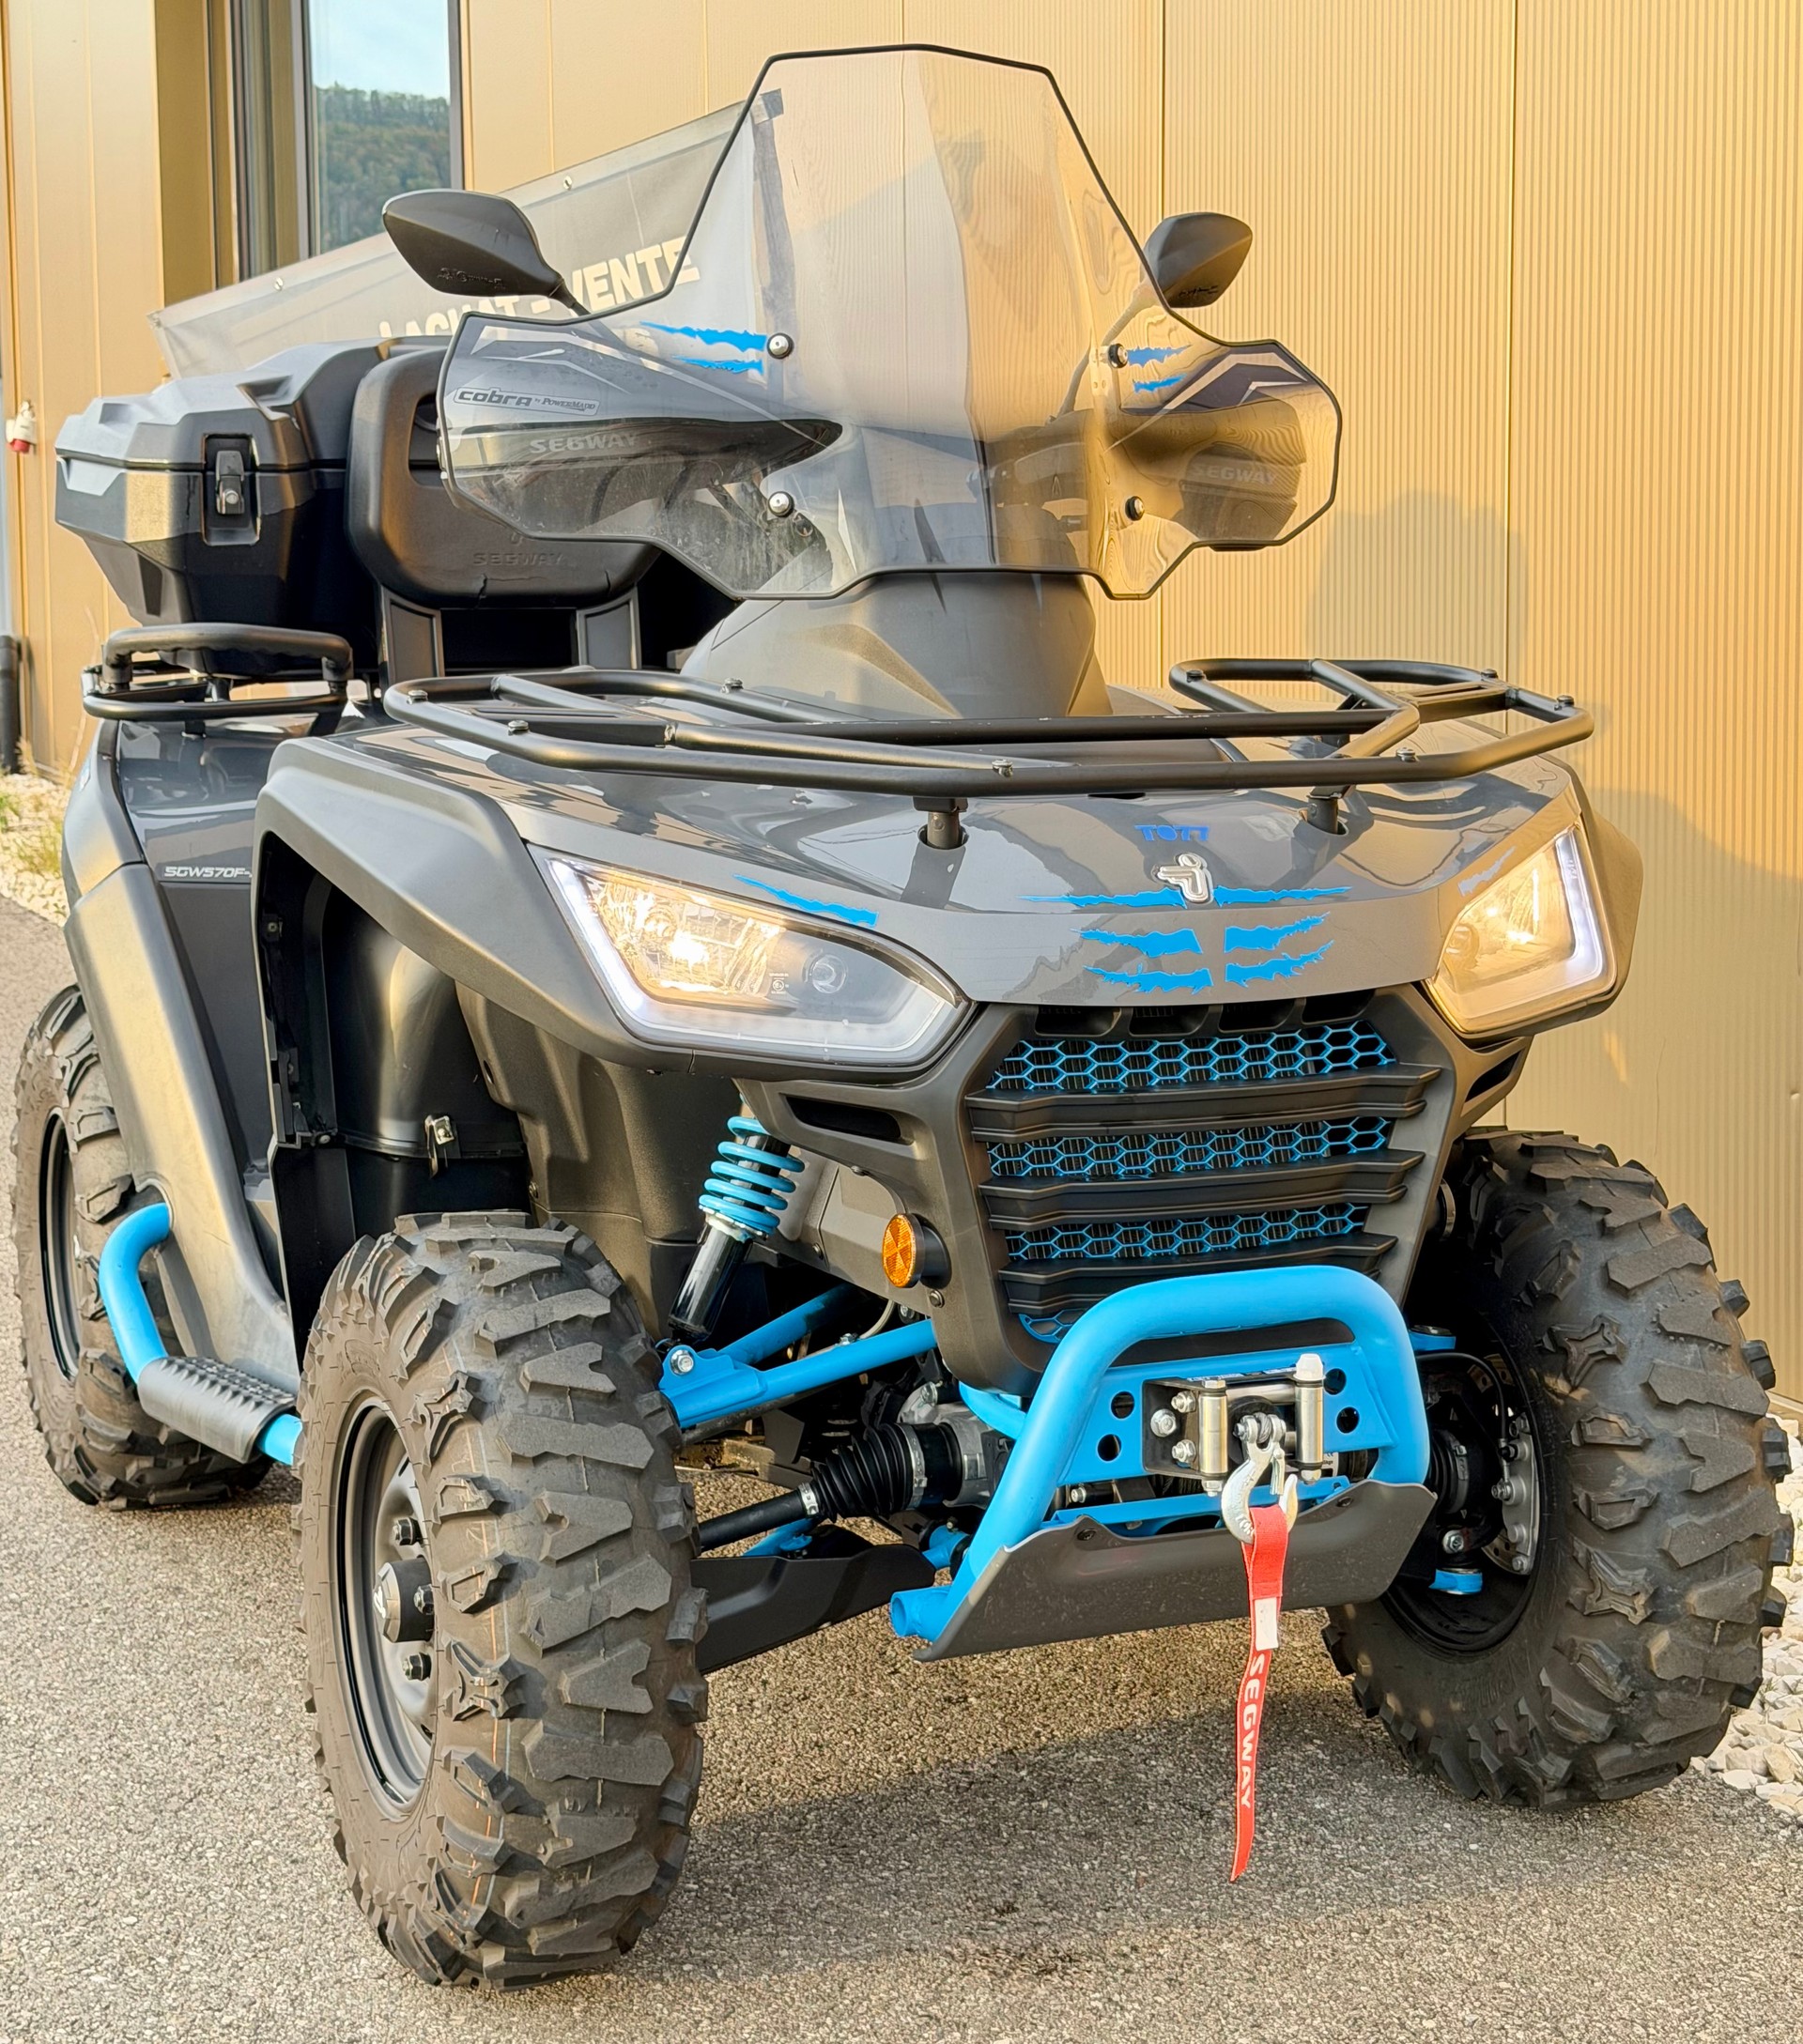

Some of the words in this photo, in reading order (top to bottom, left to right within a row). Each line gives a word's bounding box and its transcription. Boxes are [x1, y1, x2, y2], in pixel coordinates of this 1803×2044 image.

[458, 390, 532, 407] cobra
[530, 435, 639, 453] SEGWAY
[1193, 465, 1276, 484] SEGWAY
[472, 552, 563, 566] SEGWAY
[163, 866, 253, 879] SGW570F-
[1241, 1652, 1265, 1809] SEGWAY
